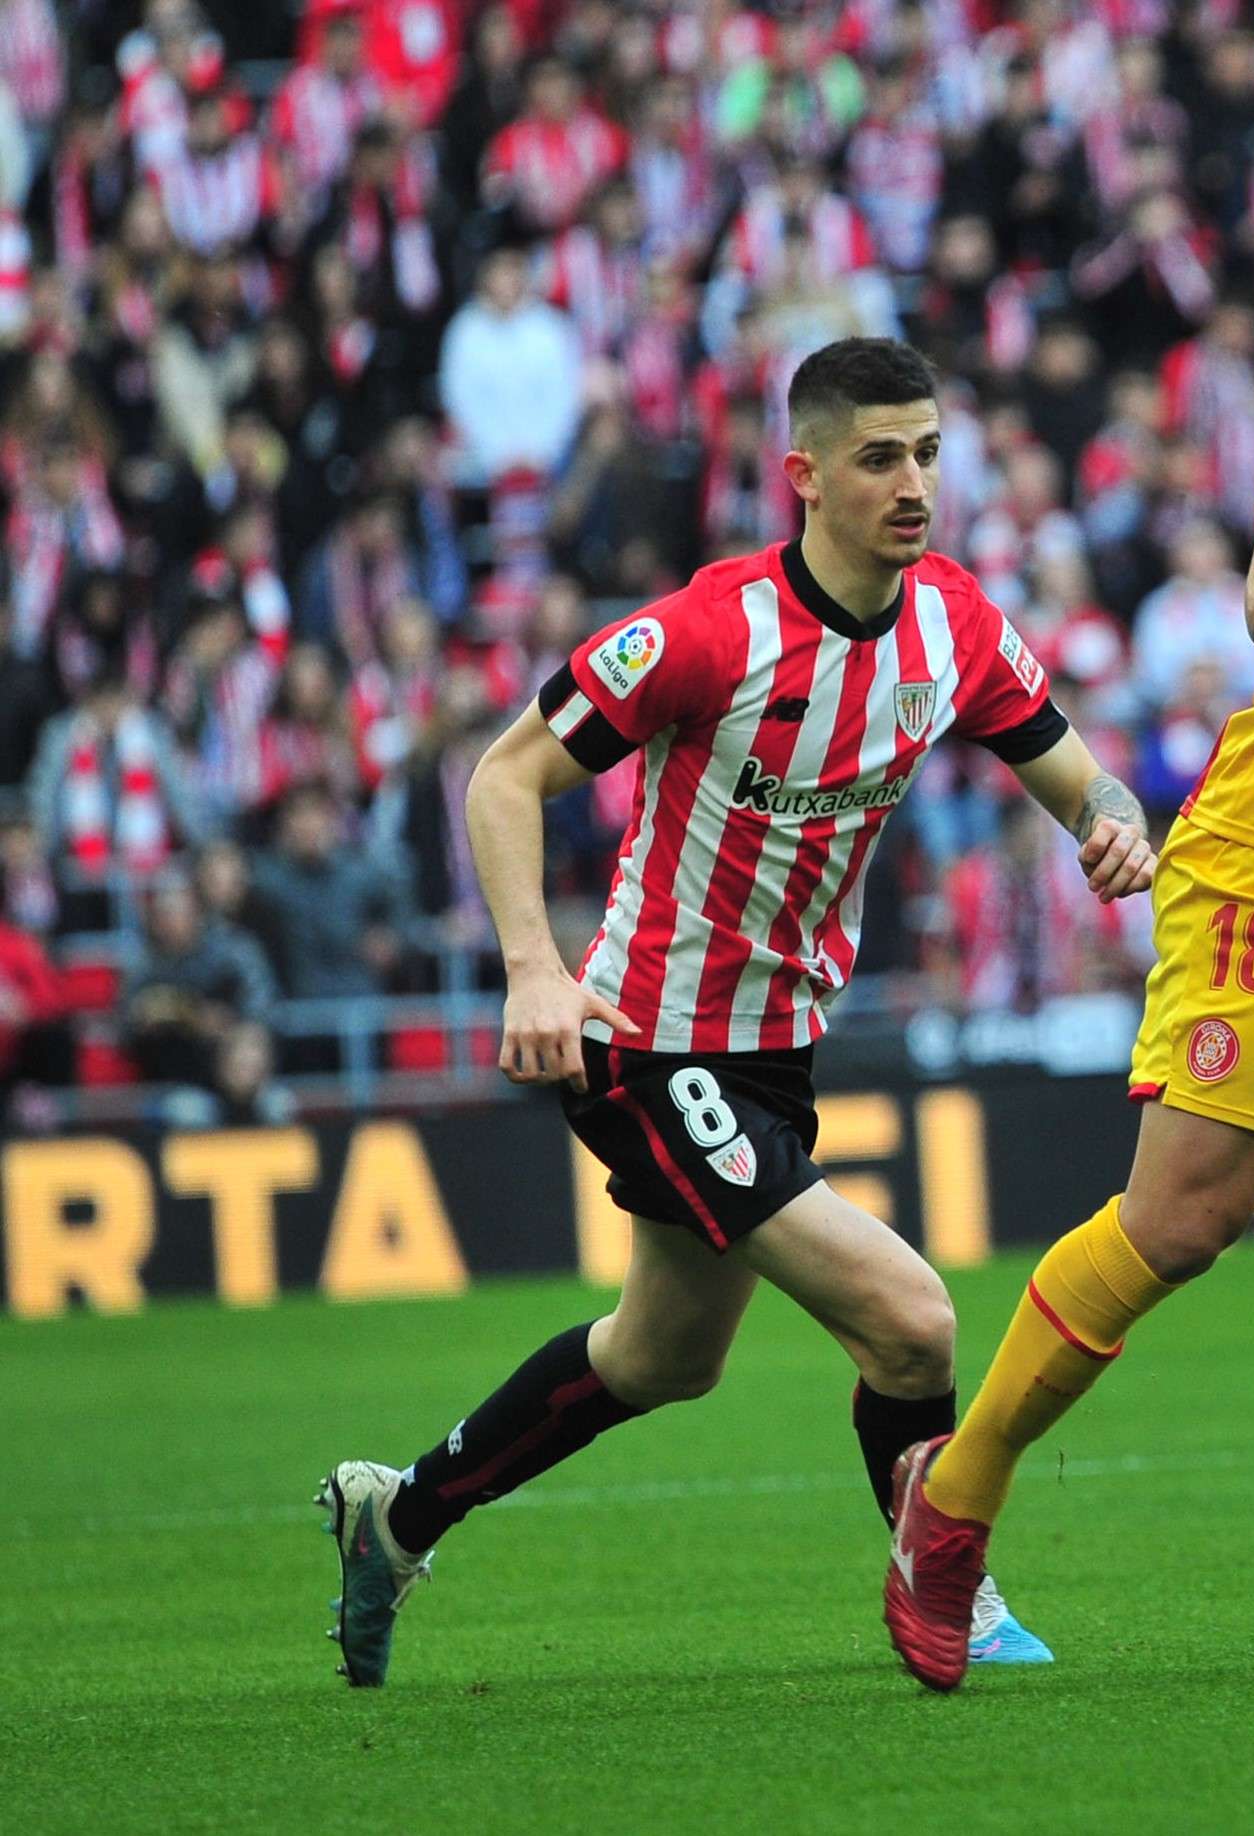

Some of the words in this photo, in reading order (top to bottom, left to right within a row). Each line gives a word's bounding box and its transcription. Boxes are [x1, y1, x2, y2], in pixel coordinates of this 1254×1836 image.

[599, 649, 629, 689] LaLiga
[732, 760, 905, 815] Kutxabank
[668, 1066, 738, 1148] 8
[3, 1120, 469, 1320] RTA
